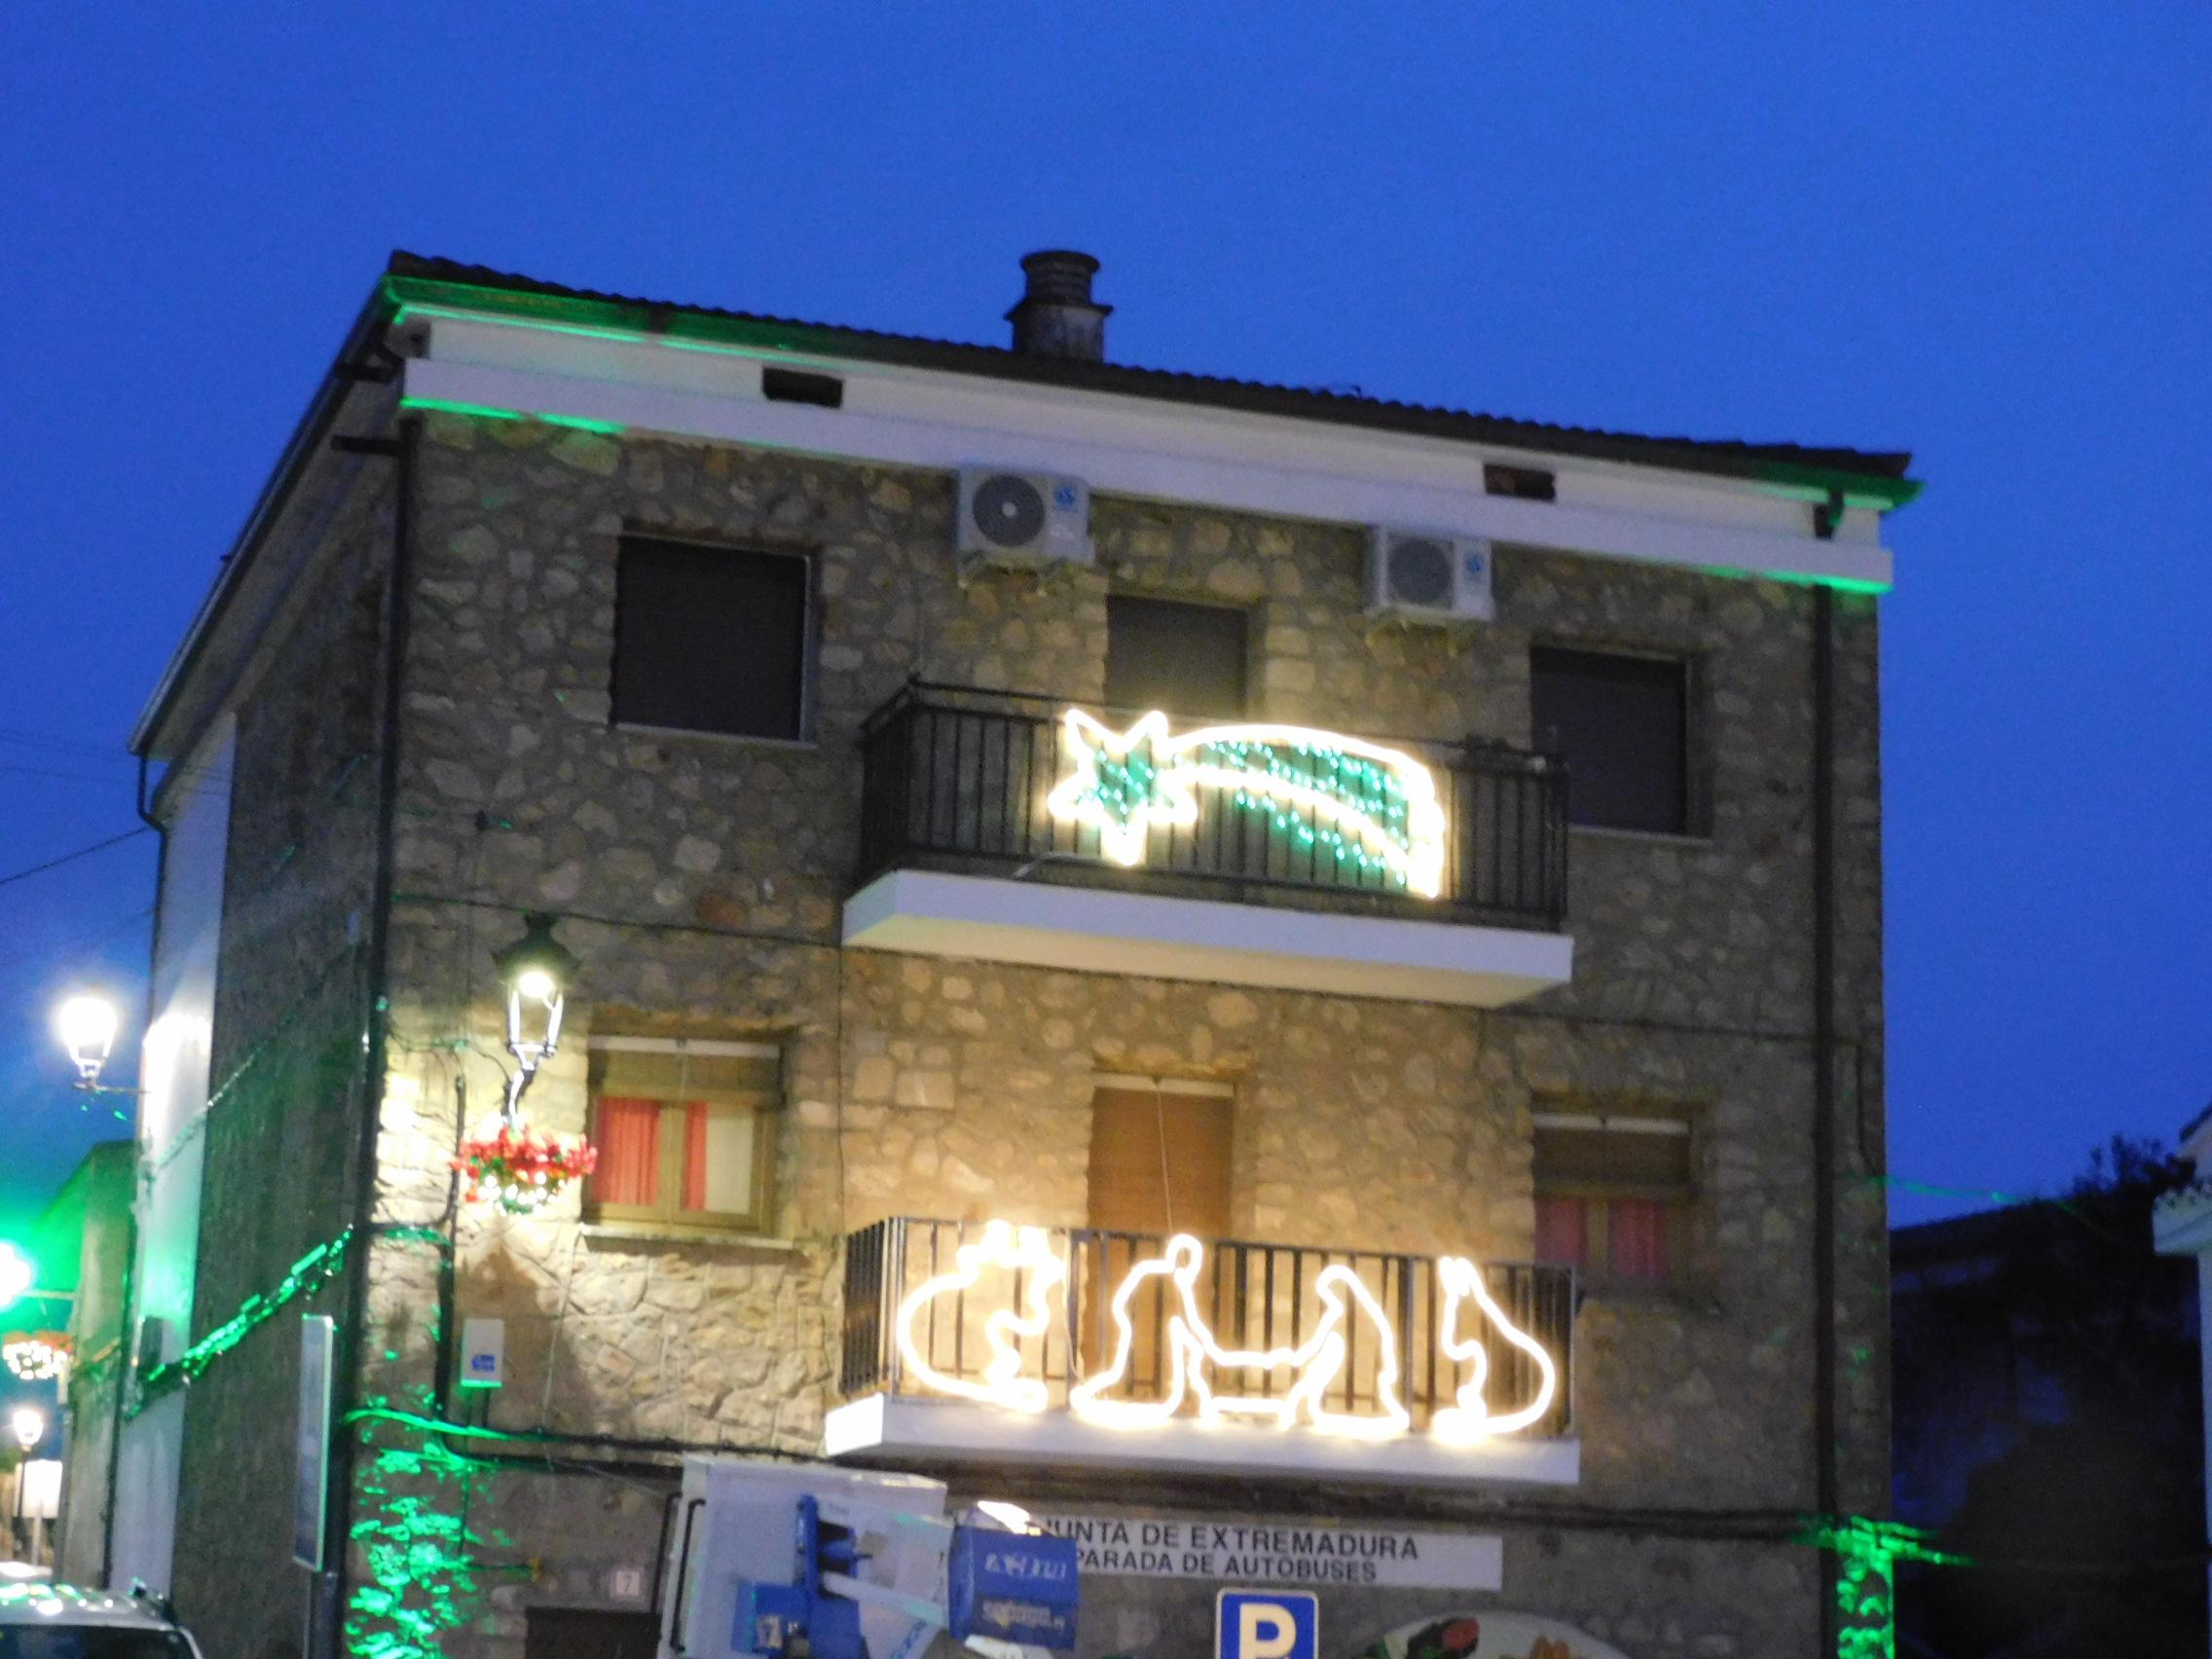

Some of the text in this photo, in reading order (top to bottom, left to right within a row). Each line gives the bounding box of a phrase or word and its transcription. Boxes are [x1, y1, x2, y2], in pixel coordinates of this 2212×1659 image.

[1142, 1523, 1180, 1548] DE
[1190, 1526, 1419, 1560] EXTREMADURA
[1182, 1552, 1215, 1574] DE
[1224, 1555, 1378, 1582] AUTOBUSES
[1239, 1603, 1297, 1659] P
